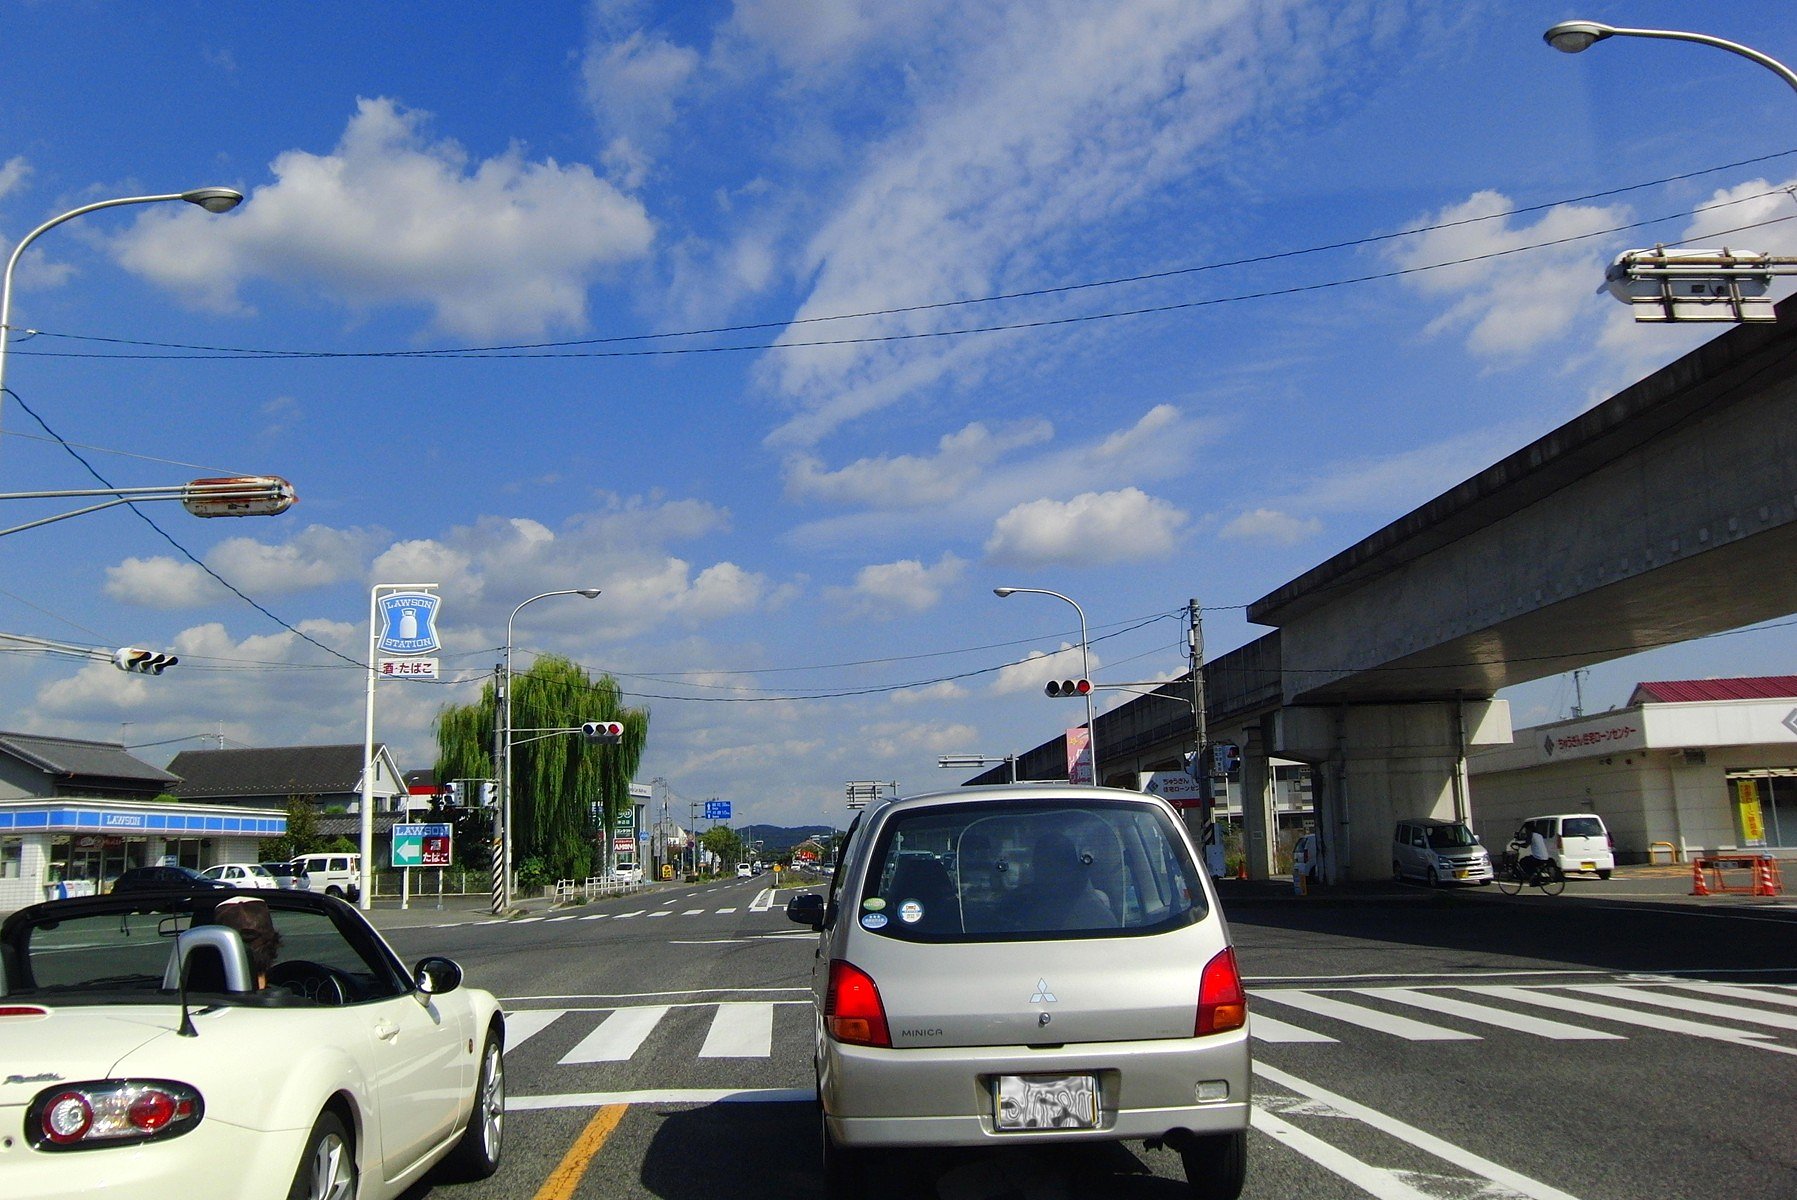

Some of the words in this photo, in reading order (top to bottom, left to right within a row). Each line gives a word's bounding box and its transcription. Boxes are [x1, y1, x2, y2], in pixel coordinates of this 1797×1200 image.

[385, 599, 433, 609] LAWSON
[385, 637, 432, 648] STATION
[382, 662, 432, 674] 酒・たばこ
[106, 814, 142, 826] LAWSON
[395, 826, 449, 836] LAWSON
[430, 839, 442, 851] 酒
[422, 852, 449, 863] たばこ
[902, 1028, 943, 1037] MINICA
